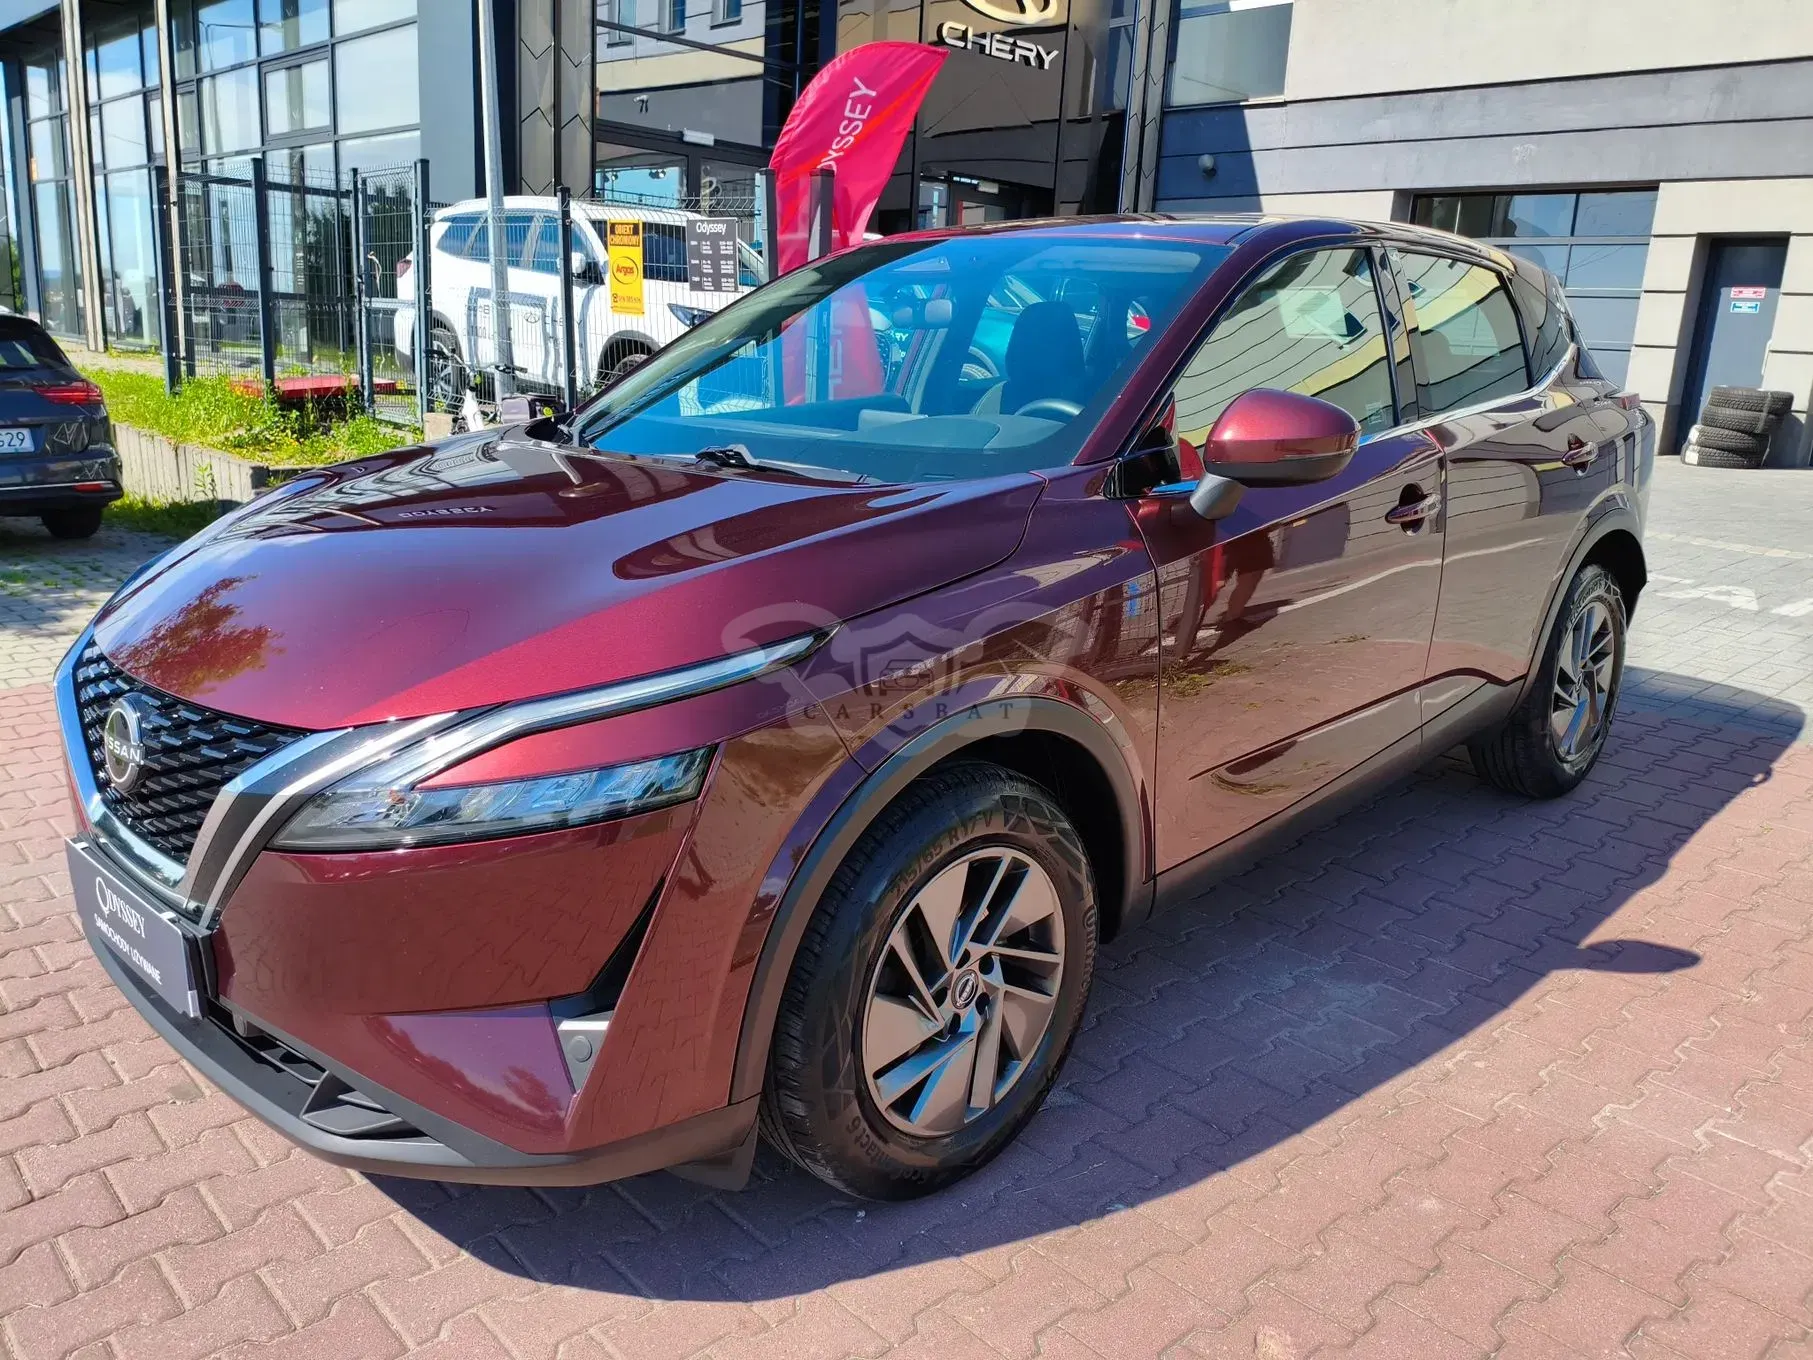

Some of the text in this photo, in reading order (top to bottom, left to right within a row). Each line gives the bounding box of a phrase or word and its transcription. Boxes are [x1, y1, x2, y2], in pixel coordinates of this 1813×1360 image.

[942, 21, 1059, 70] CHERY
[816, 76, 877, 178] DYSSEY
[696, 221, 727, 236] Odyssey
[616, 263, 635, 276] Argos
[107, 736, 140, 763] SSAN
[95, 876, 146, 939] ODYSSEY
